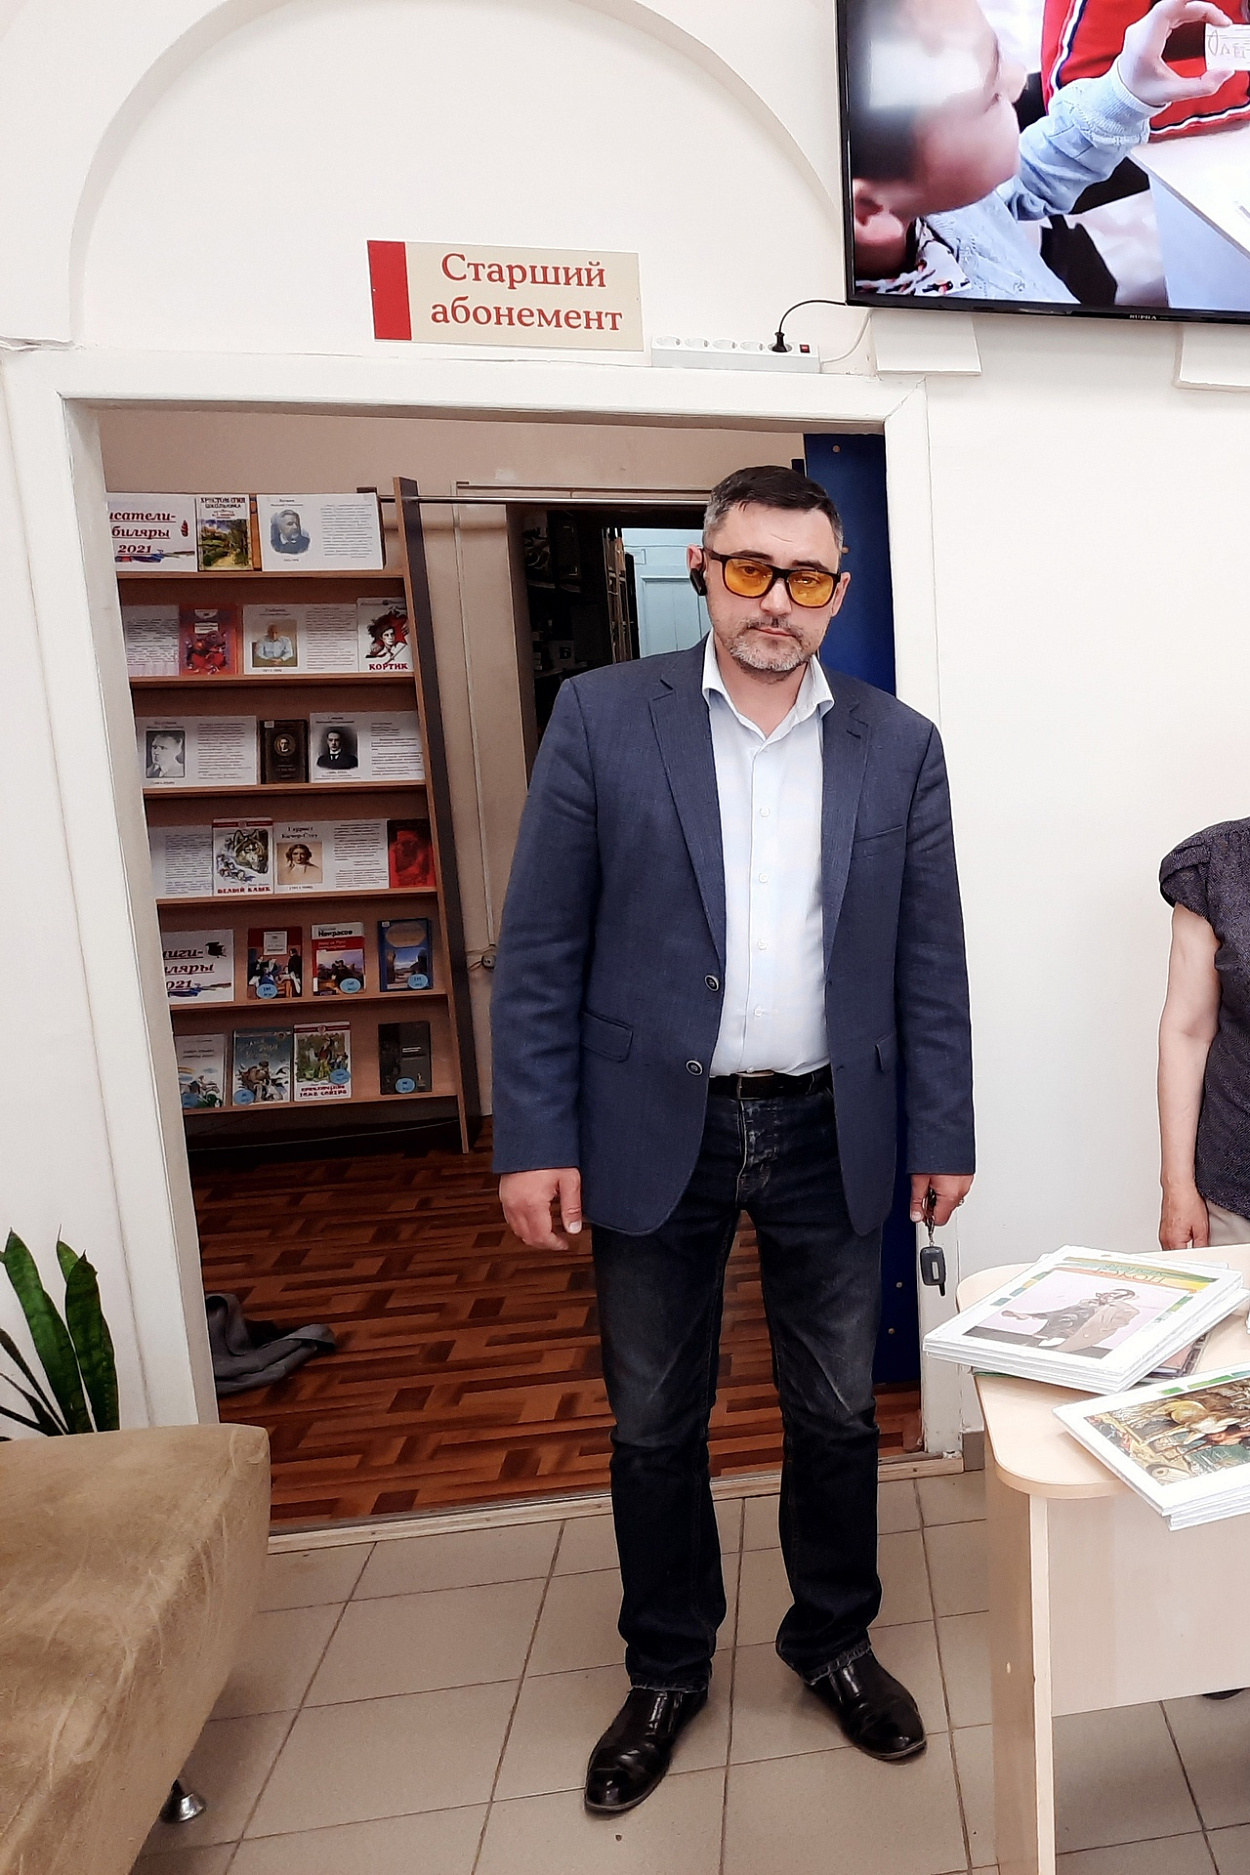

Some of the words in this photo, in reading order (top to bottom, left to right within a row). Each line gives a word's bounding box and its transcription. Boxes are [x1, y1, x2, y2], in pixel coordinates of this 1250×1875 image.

[441, 252, 607, 291] Старший
[430, 296, 623, 332] абонемент
[117, 544, 153, 554] 2021
[369, 663, 408, 671] КОРТИК
